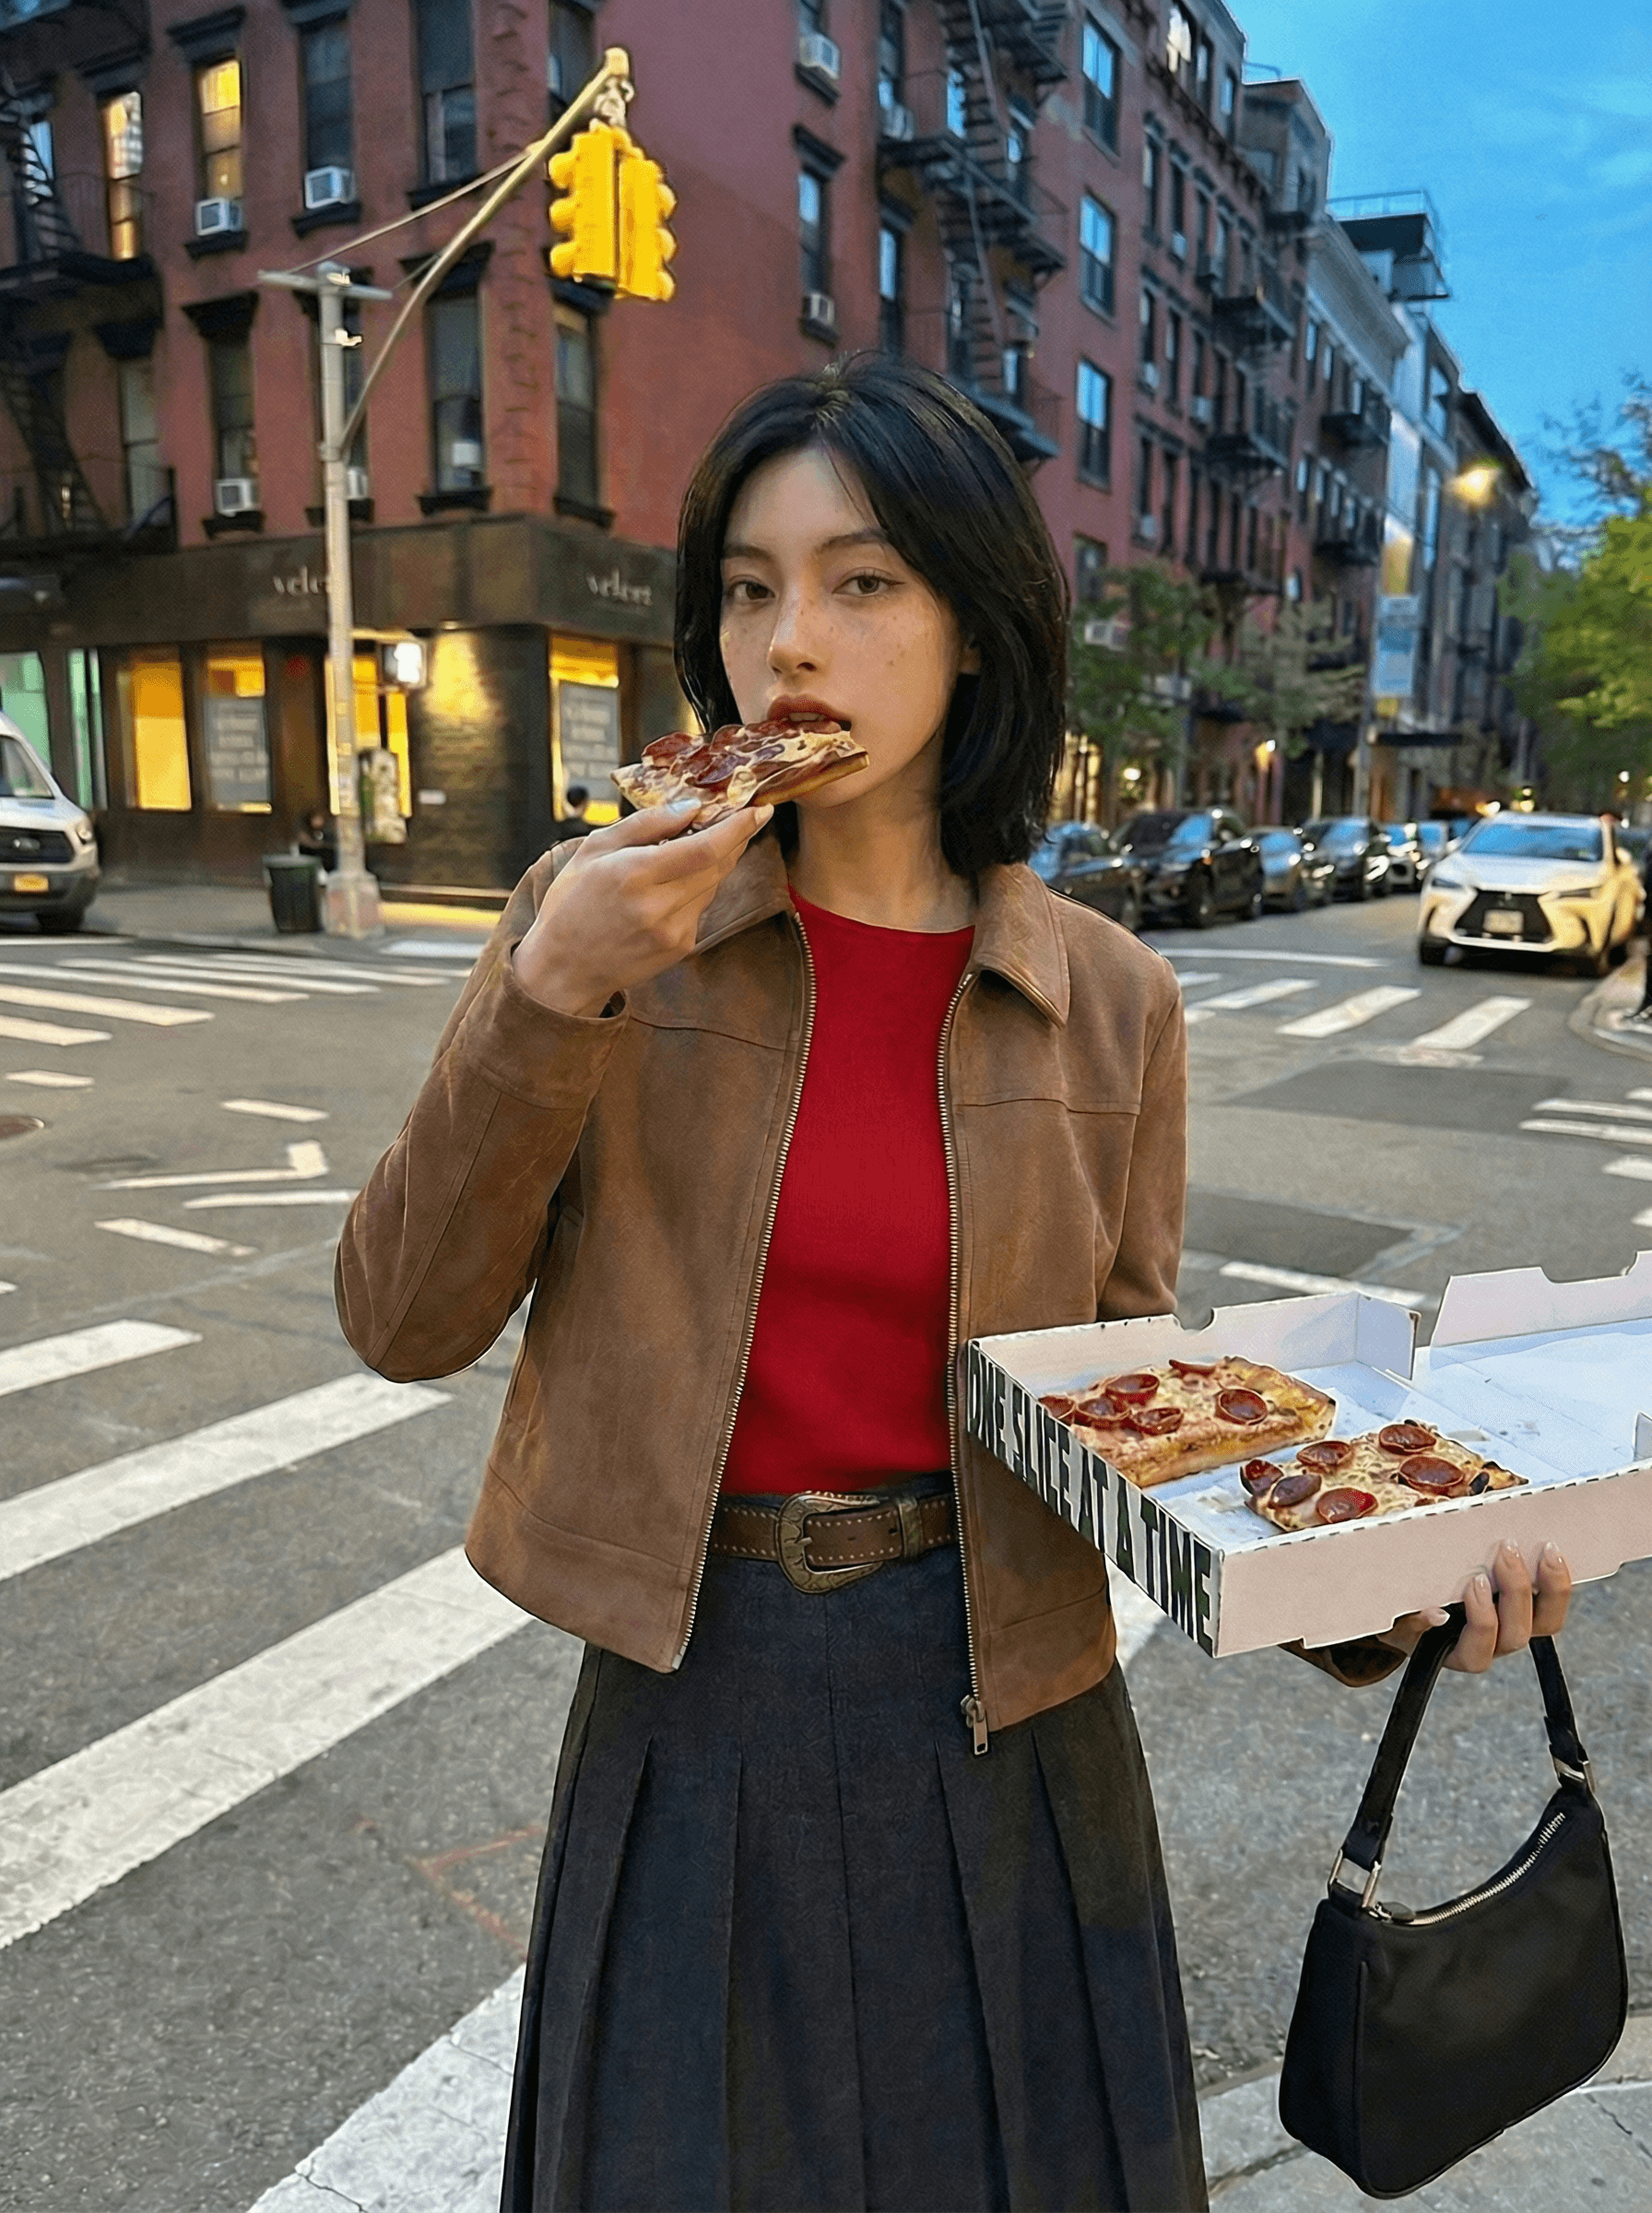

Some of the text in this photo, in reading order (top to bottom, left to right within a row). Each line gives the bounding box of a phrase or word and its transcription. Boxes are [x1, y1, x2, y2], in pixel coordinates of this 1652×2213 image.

[969, 1343, 1213, 1659] ONE SLICE AT A TIME
